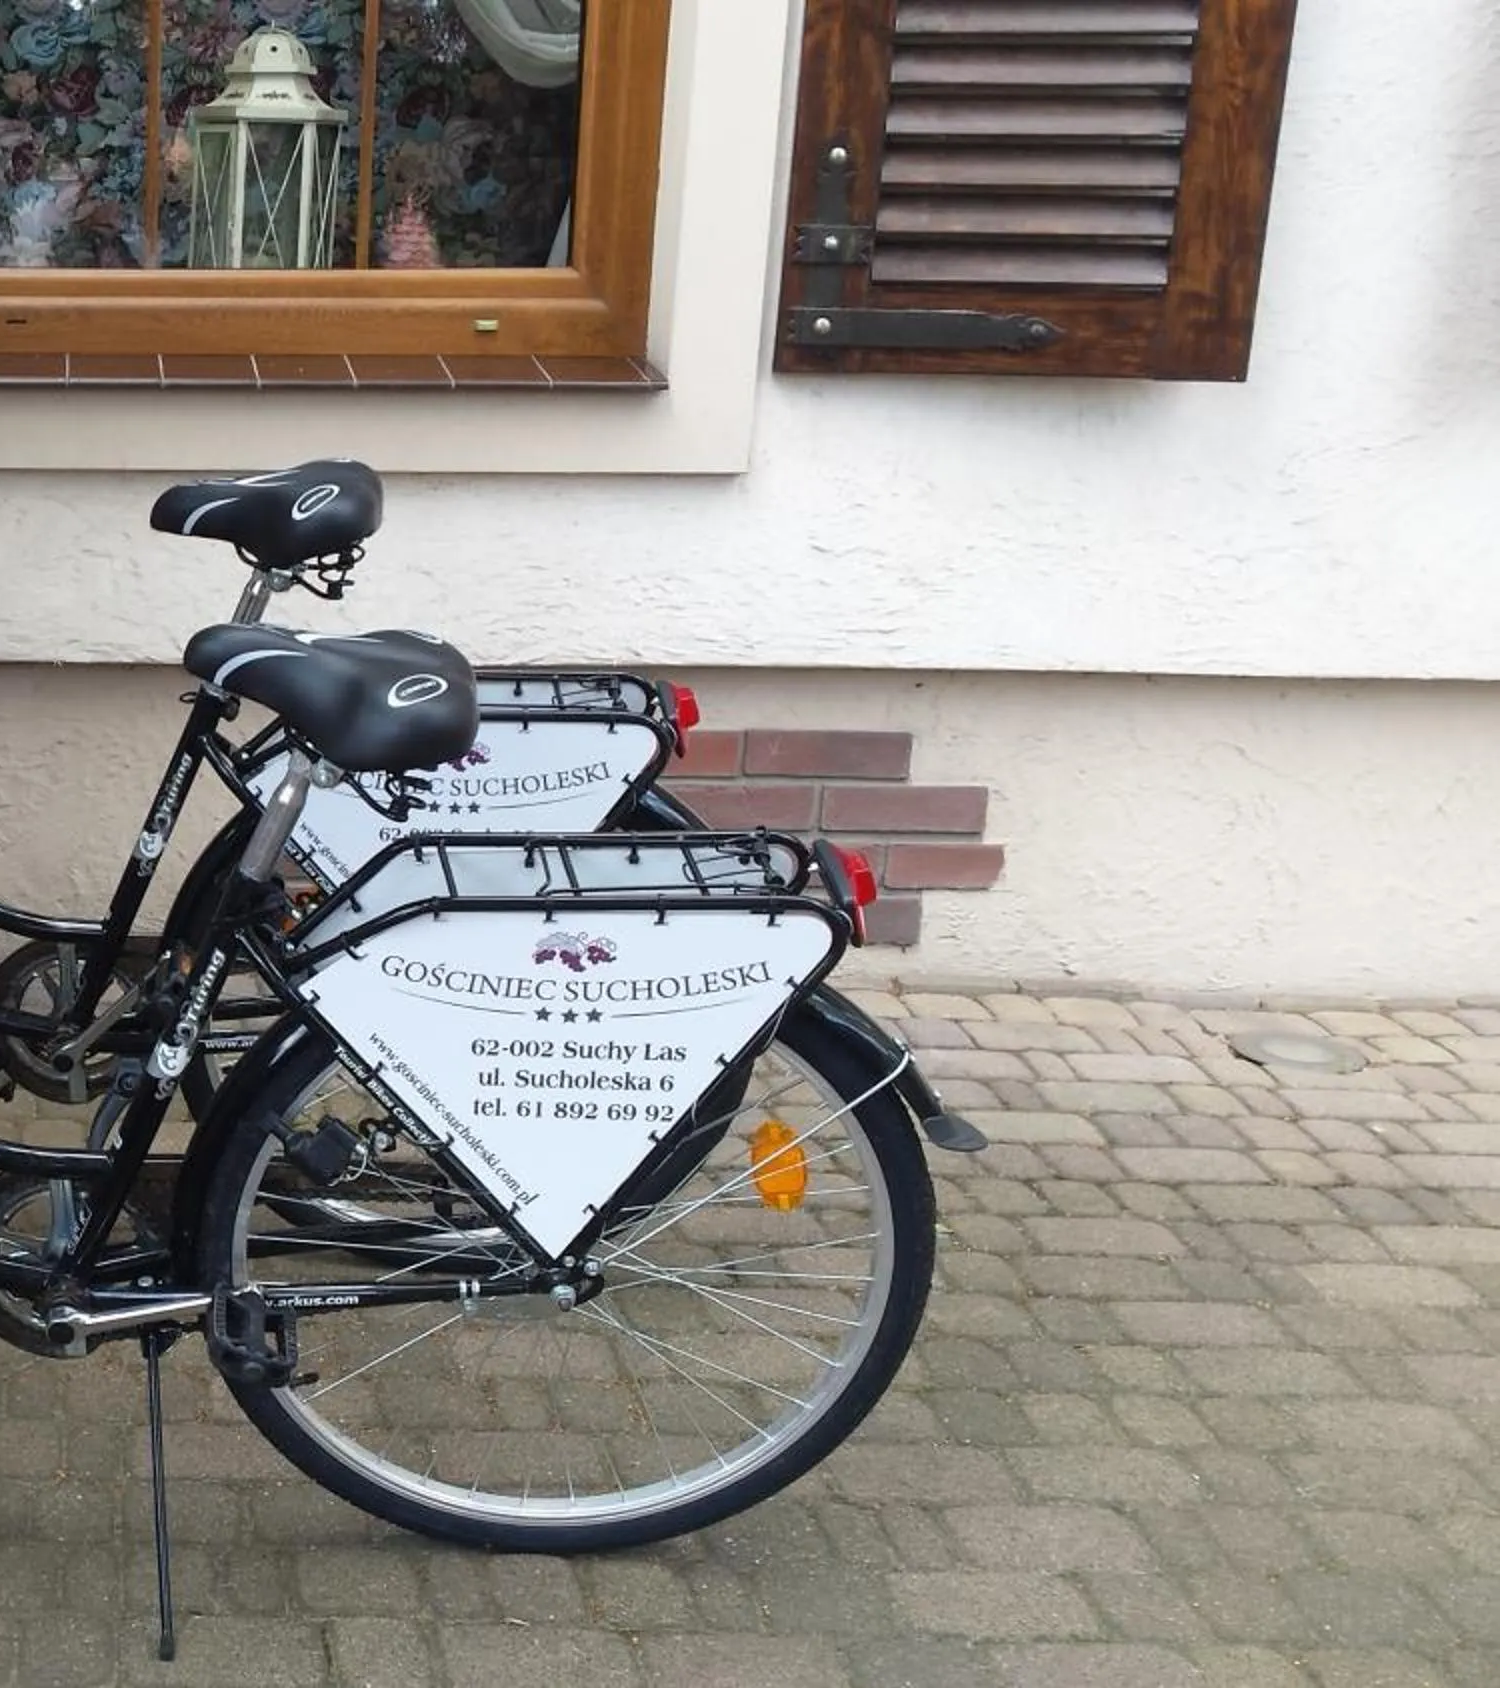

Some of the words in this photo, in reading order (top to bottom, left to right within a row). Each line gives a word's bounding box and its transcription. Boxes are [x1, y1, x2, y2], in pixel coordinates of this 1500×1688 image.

[450, 761, 611, 797] SUCHOLESKI
[381, 955, 557, 1001] GOŚCINIEC
[563, 961, 773, 1002] SUCHOLESKI
[471, 1038, 554, 1058] 62-002
[562, 1040, 637, 1064] Suchy
[643, 1043, 687, 1061] Las
[479, 1068, 504, 1086] ul.
[514, 1069, 651, 1091] Sucholeska
[659, 1075, 674, 1092] 6
[473, 1098, 506, 1116] tel.
[516, 1100, 542, 1118] 61
[553, 1101, 598, 1120] 892
[607, 1103, 637, 1121] 69
[645, 1105, 673, 1122] 92
